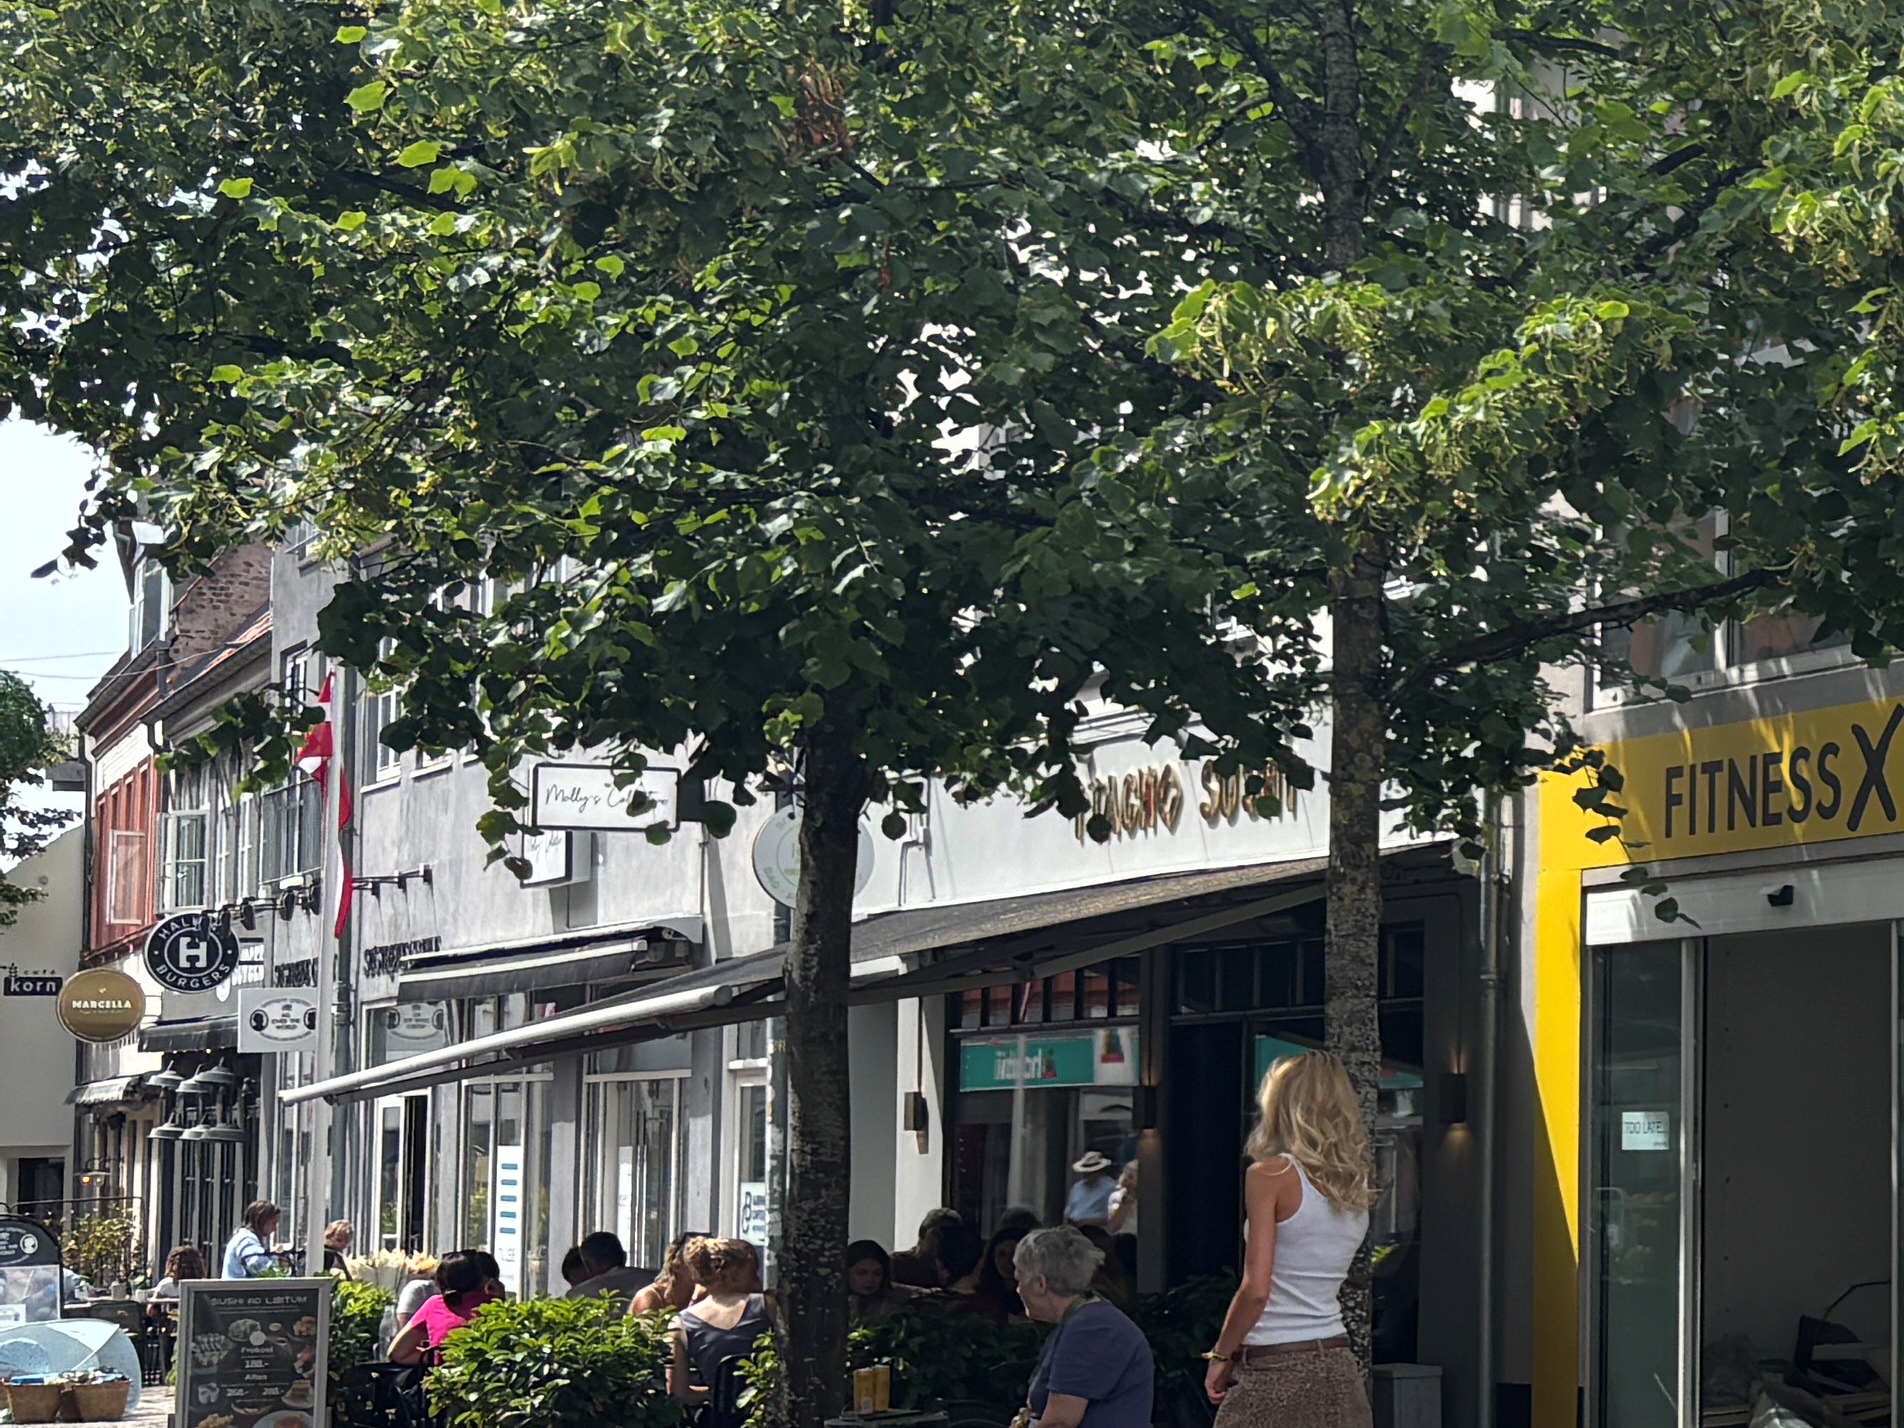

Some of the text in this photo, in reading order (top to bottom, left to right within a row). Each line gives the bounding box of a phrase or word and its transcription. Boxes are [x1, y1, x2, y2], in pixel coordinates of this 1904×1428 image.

[155, 963, 230, 989] BURGERS
[10, 977, 56, 992] korn
[72, 999, 132, 1009] MARCELLA
